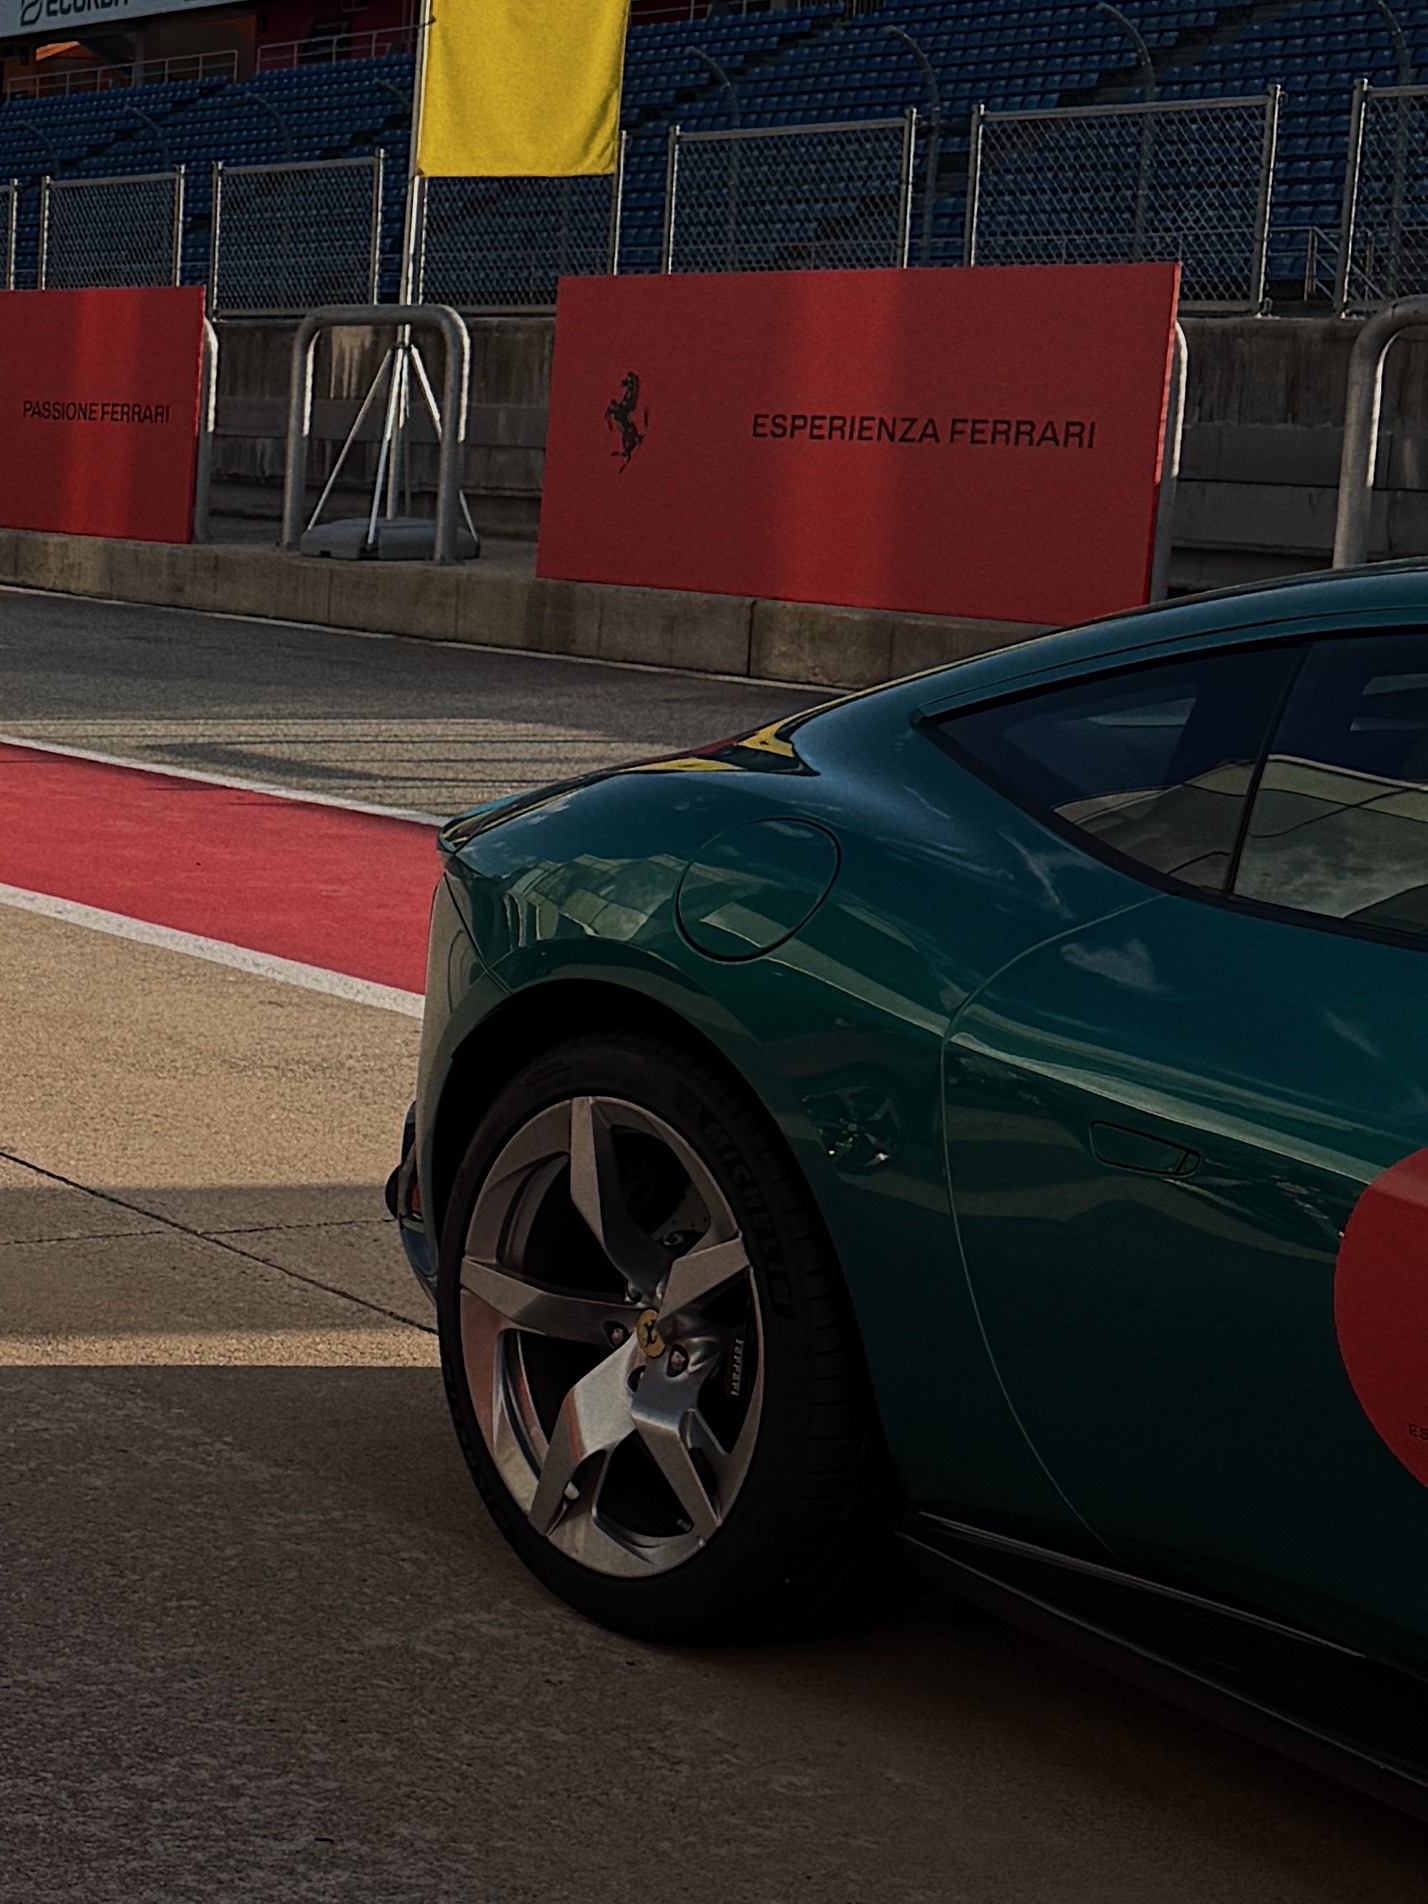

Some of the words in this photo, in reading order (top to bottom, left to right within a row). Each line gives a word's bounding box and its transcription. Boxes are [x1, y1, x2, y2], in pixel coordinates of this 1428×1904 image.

[22, 399, 98, 421] PASSIONE
[100, 402, 169, 424] FERRARI
[751, 413, 940, 444] ESPERIENZA
[948, 418, 1096, 449] FERRARI
